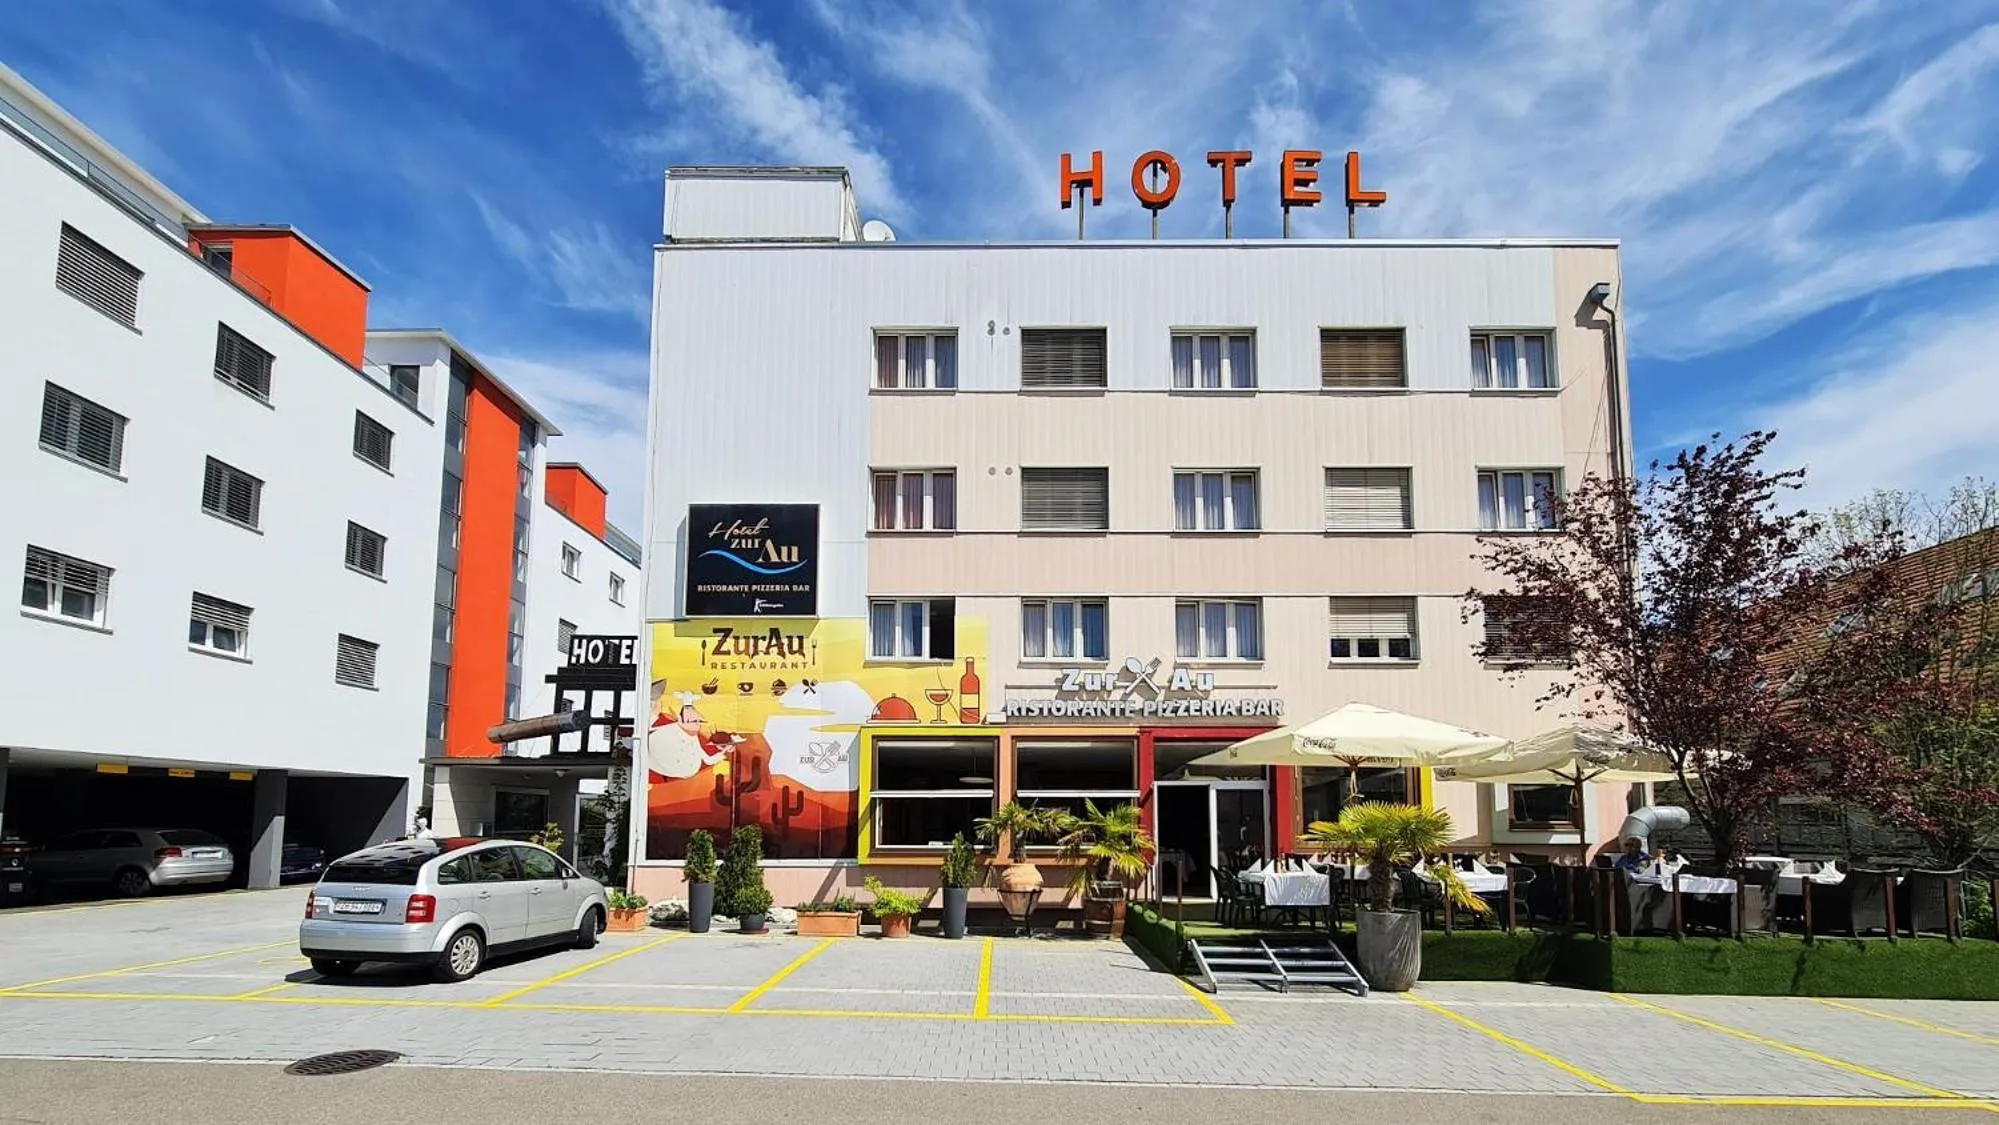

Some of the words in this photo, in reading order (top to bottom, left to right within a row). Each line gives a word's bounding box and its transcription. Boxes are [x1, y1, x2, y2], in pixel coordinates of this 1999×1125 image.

[1060, 150, 1387, 209] HOTEL
[708, 517, 770, 540] Hotel
[731, 539, 759, 549] zur
[757, 539, 799, 563] Au
[697, 584, 749, 593] RISTORANTE
[751, 584, 790, 592] PIZZERIA
[792, 584, 810, 592] BAR
[710, 661, 808, 669] RESTAURANT
[1061, 668, 1118, 692] Zur
[1170, 668, 1215, 691] Au
[1005, 699, 1136, 717] RISTORANTE
[1143, 699, 1236, 717] PIZZERIA
[1241, 698, 1285, 716] BAR
